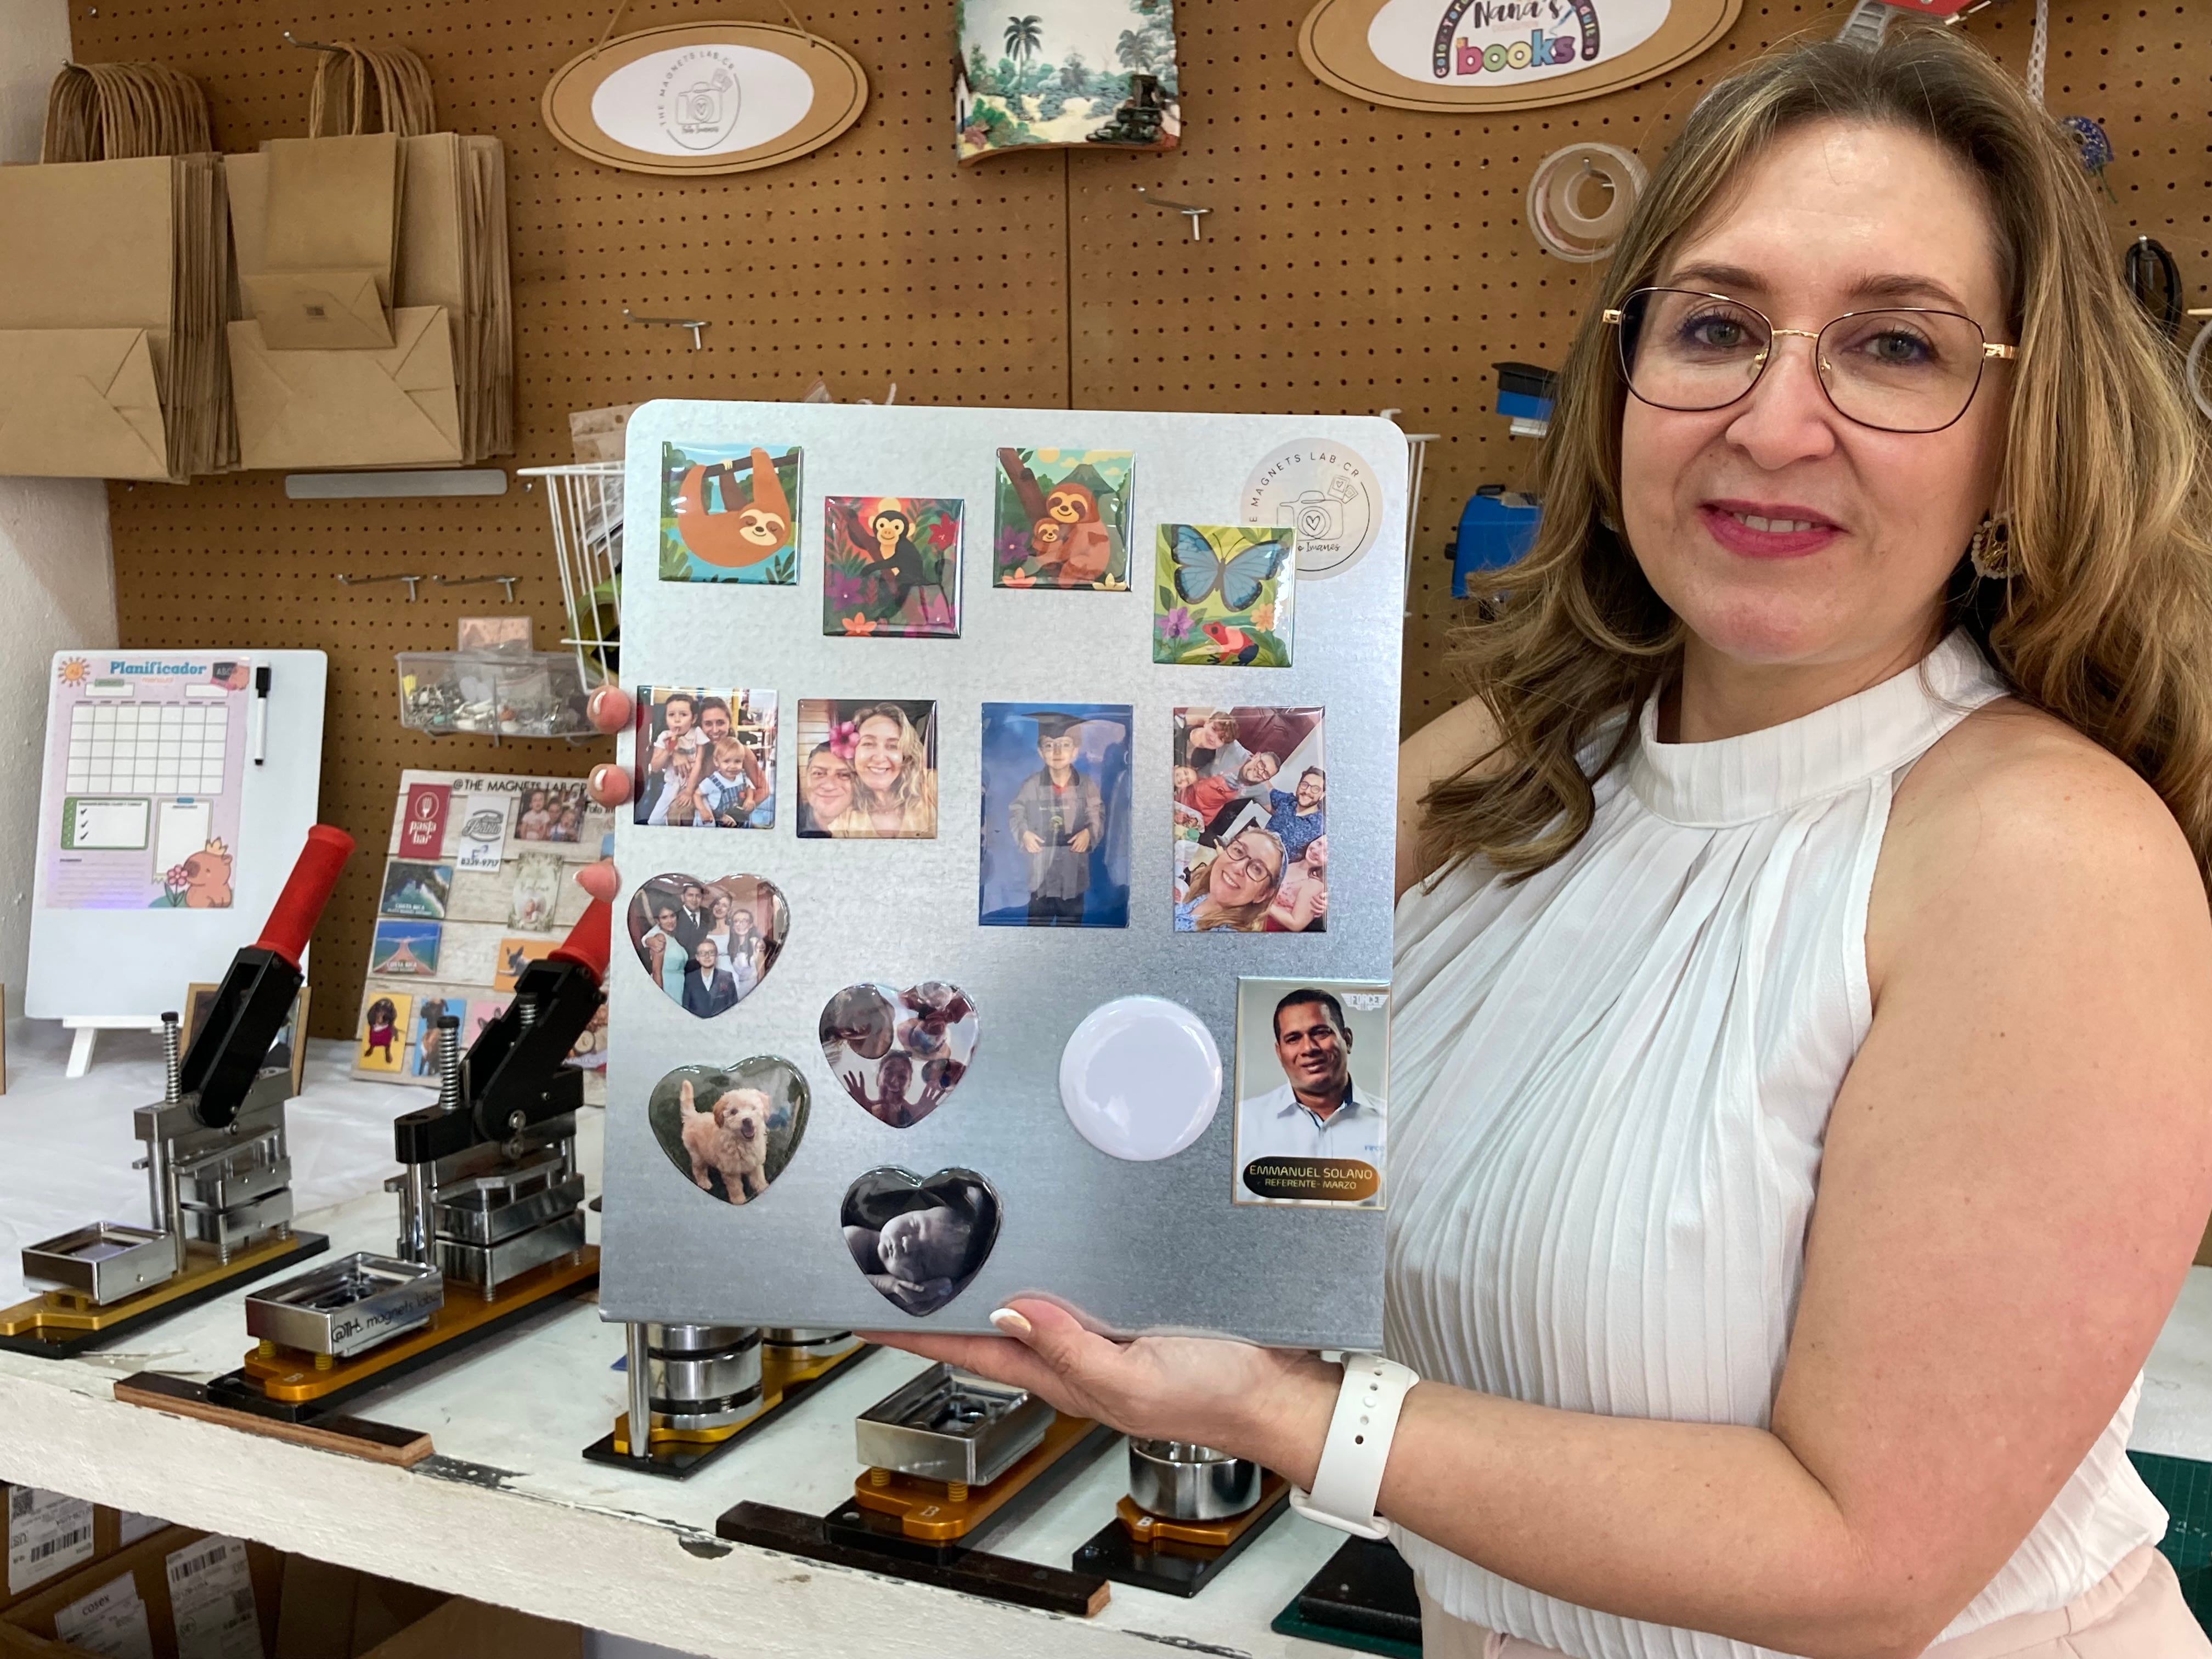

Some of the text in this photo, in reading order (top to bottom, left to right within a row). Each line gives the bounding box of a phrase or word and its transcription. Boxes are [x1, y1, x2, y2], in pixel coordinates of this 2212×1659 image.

[1475, 0, 1563, 29] Nanas
[1457, 29, 1576, 75] books
[1250, 454, 1301, 507] MAGNETS
[1306, 541, 1341, 553] Imanes
[110, 661, 207, 675] Planificador
[1249, 1165, 1373, 1180] EMMANUEL SOLANO
[1322, 1180, 1357, 1189] MARZO
